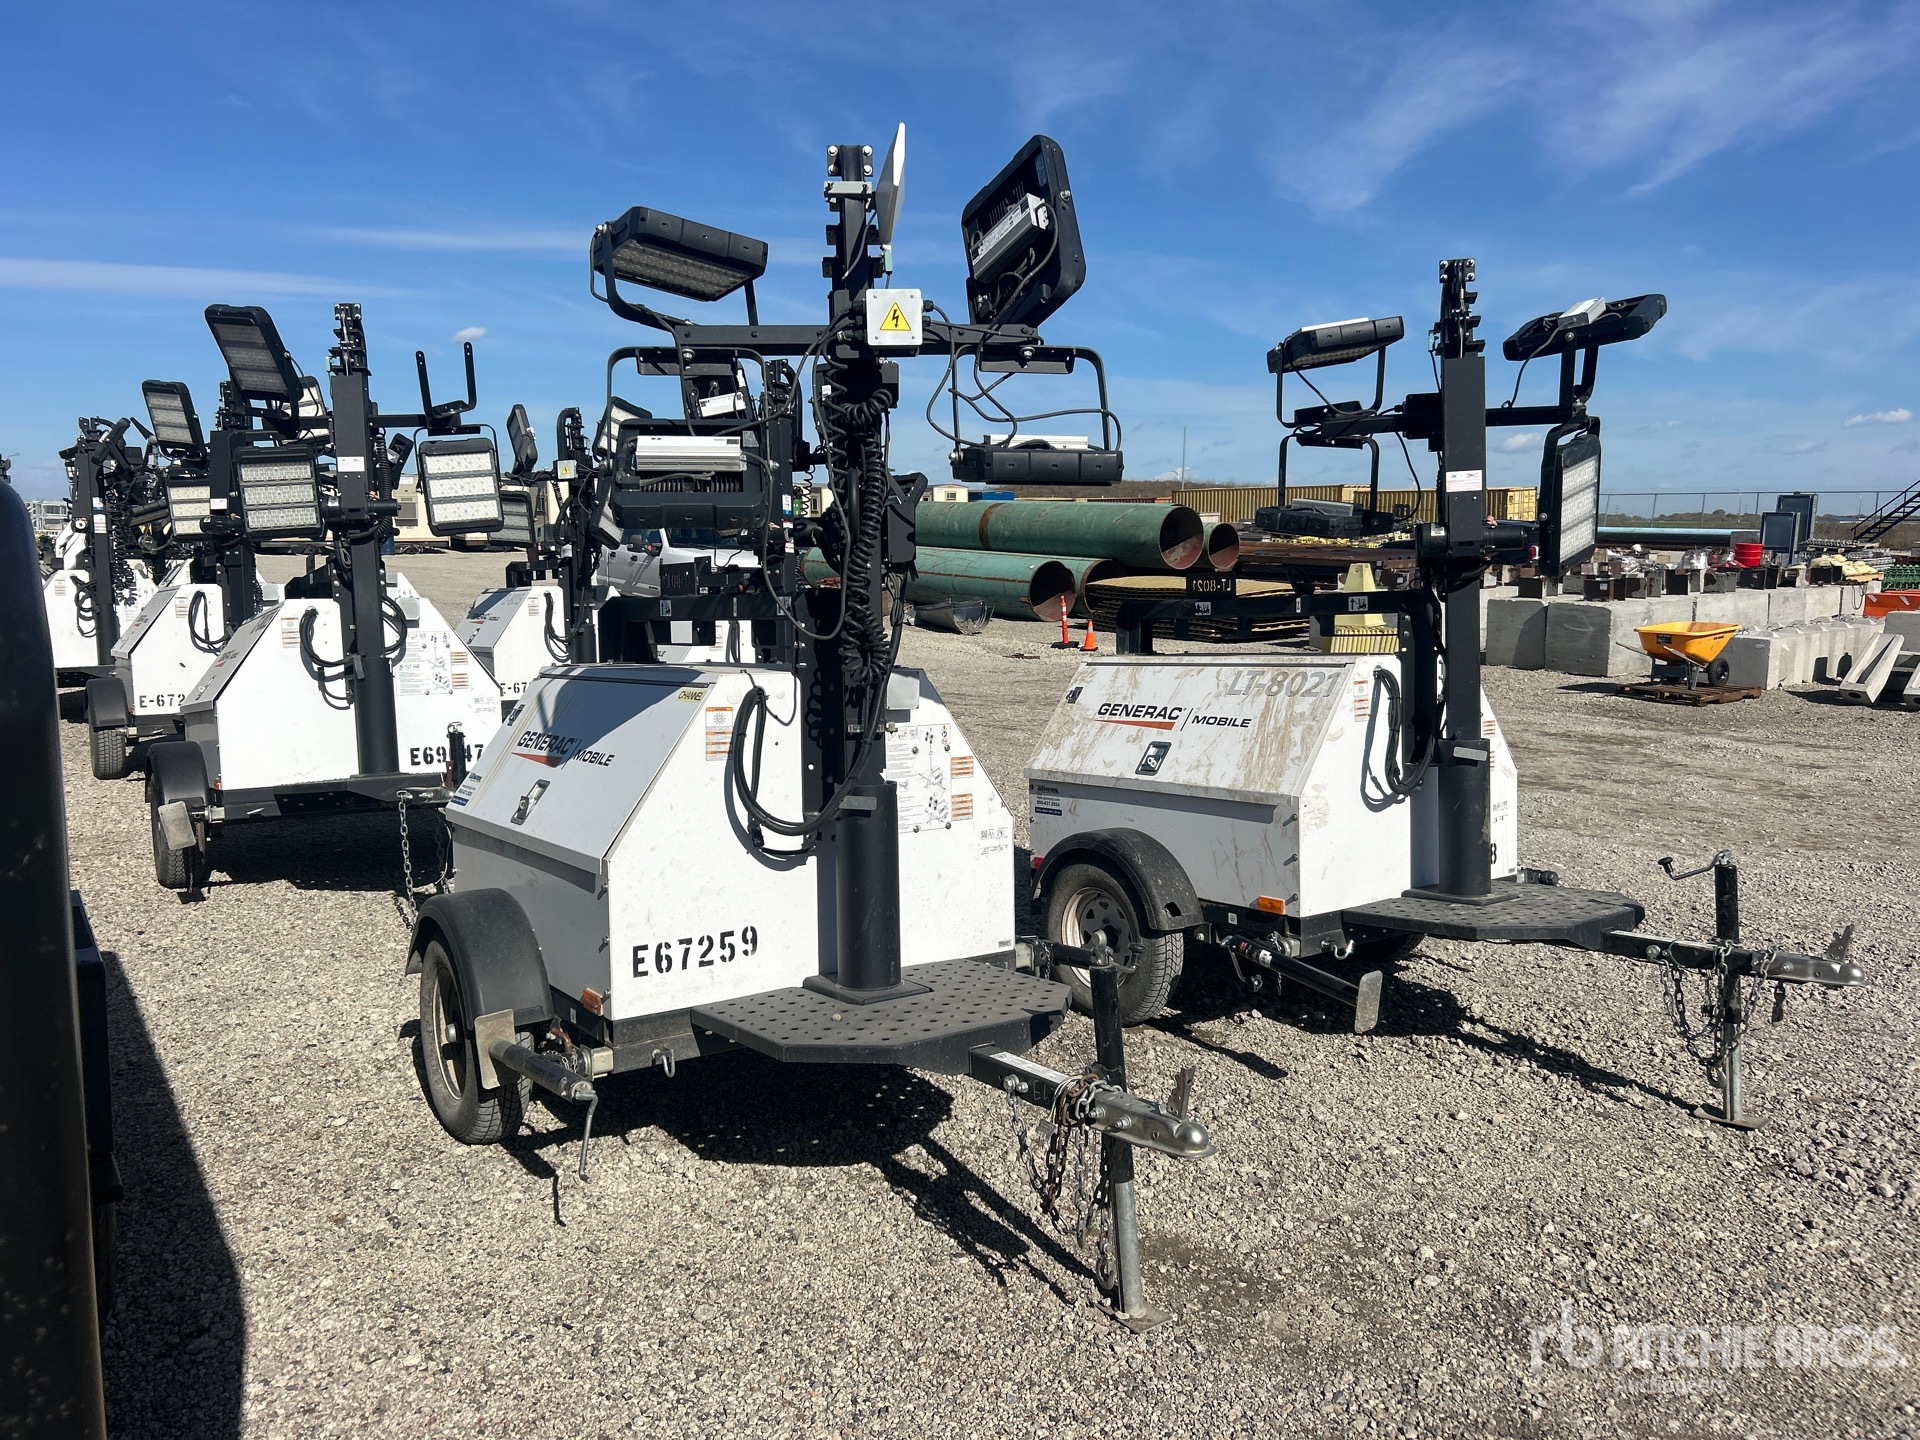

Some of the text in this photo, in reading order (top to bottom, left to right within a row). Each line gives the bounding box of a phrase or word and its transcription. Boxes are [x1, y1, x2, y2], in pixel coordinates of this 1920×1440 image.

[1226, 670, 1342, 699] LT-8021
[1097, 702, 1252, 729] GENERAC MOBILE
[409, 743, 484, 766] E6947
[517, 730, 615, 767] GENERAC MOBILE
[632, 925, 758, 979] E67259
